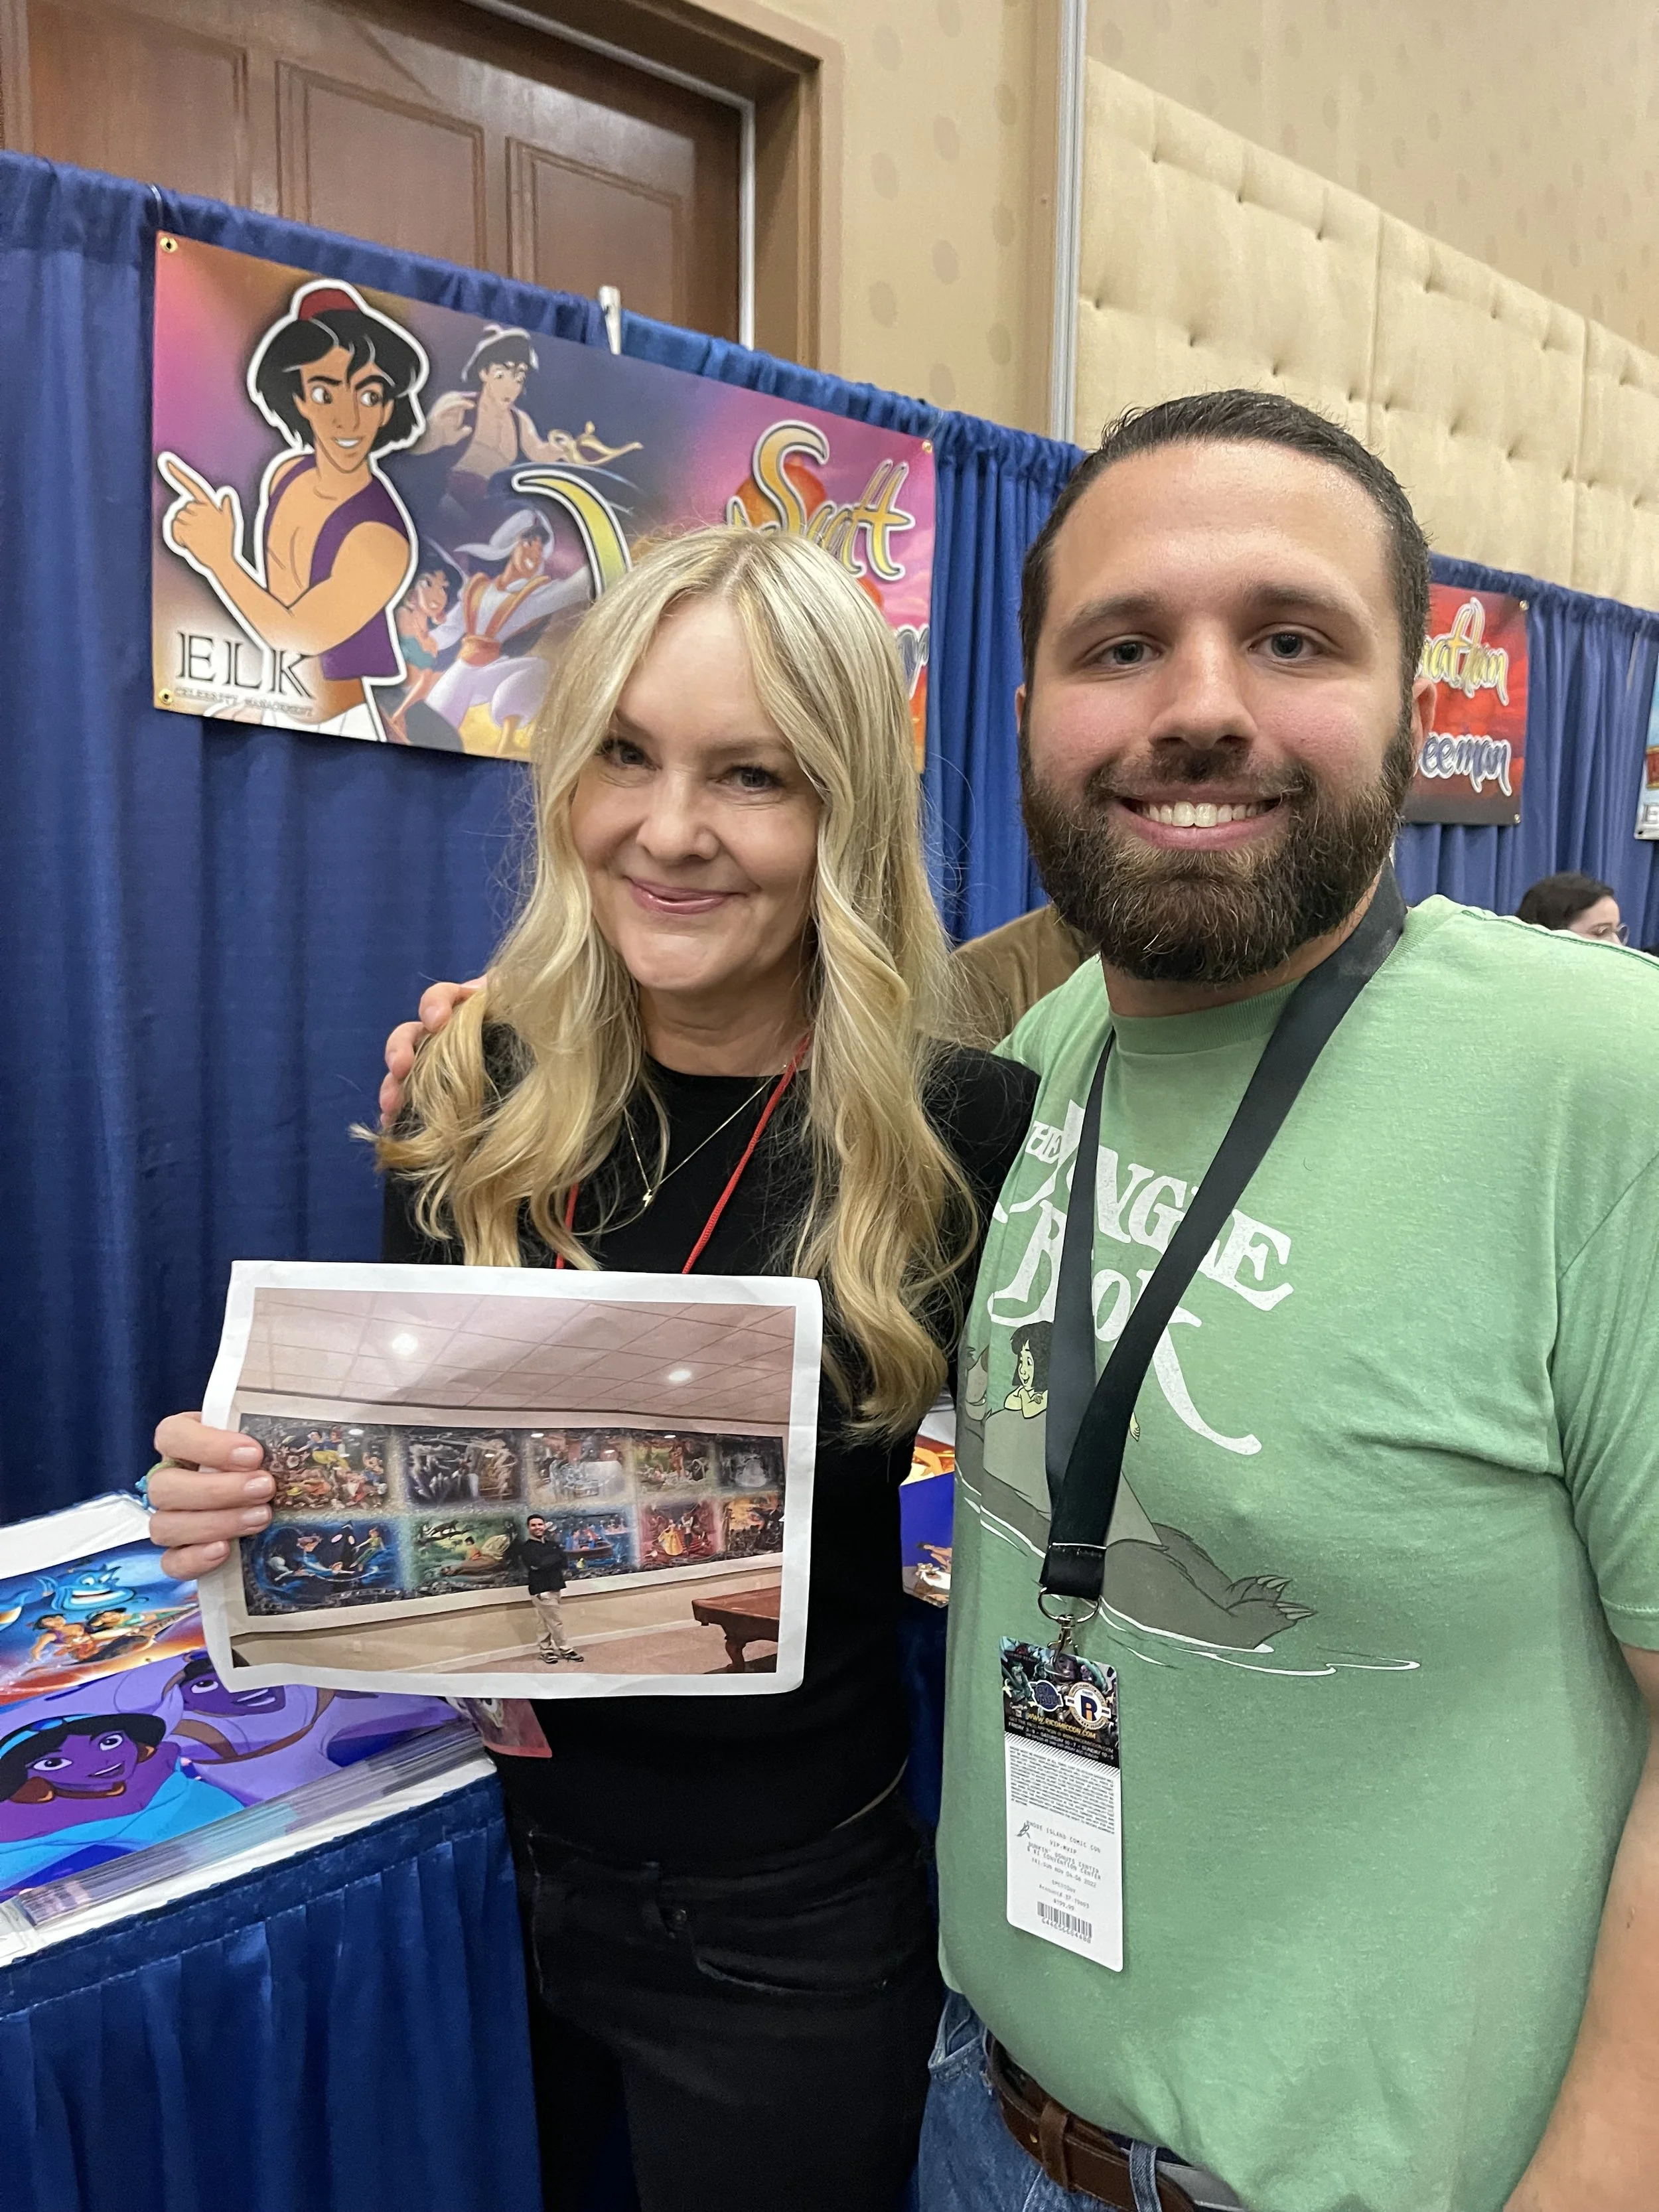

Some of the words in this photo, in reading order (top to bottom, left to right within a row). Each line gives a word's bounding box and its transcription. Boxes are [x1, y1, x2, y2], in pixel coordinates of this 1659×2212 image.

[175, 630, 317, 700] ELK
[992, 1099, 1294, 1311] JNGE
[1046, 1827, 1066, 1840] ISLAND
[1070, 1836, 1086, 1848] COMIC
[1090, 1844, 1100, 1854] CON
[1080, 1868, 1101, 1880] CENTER
